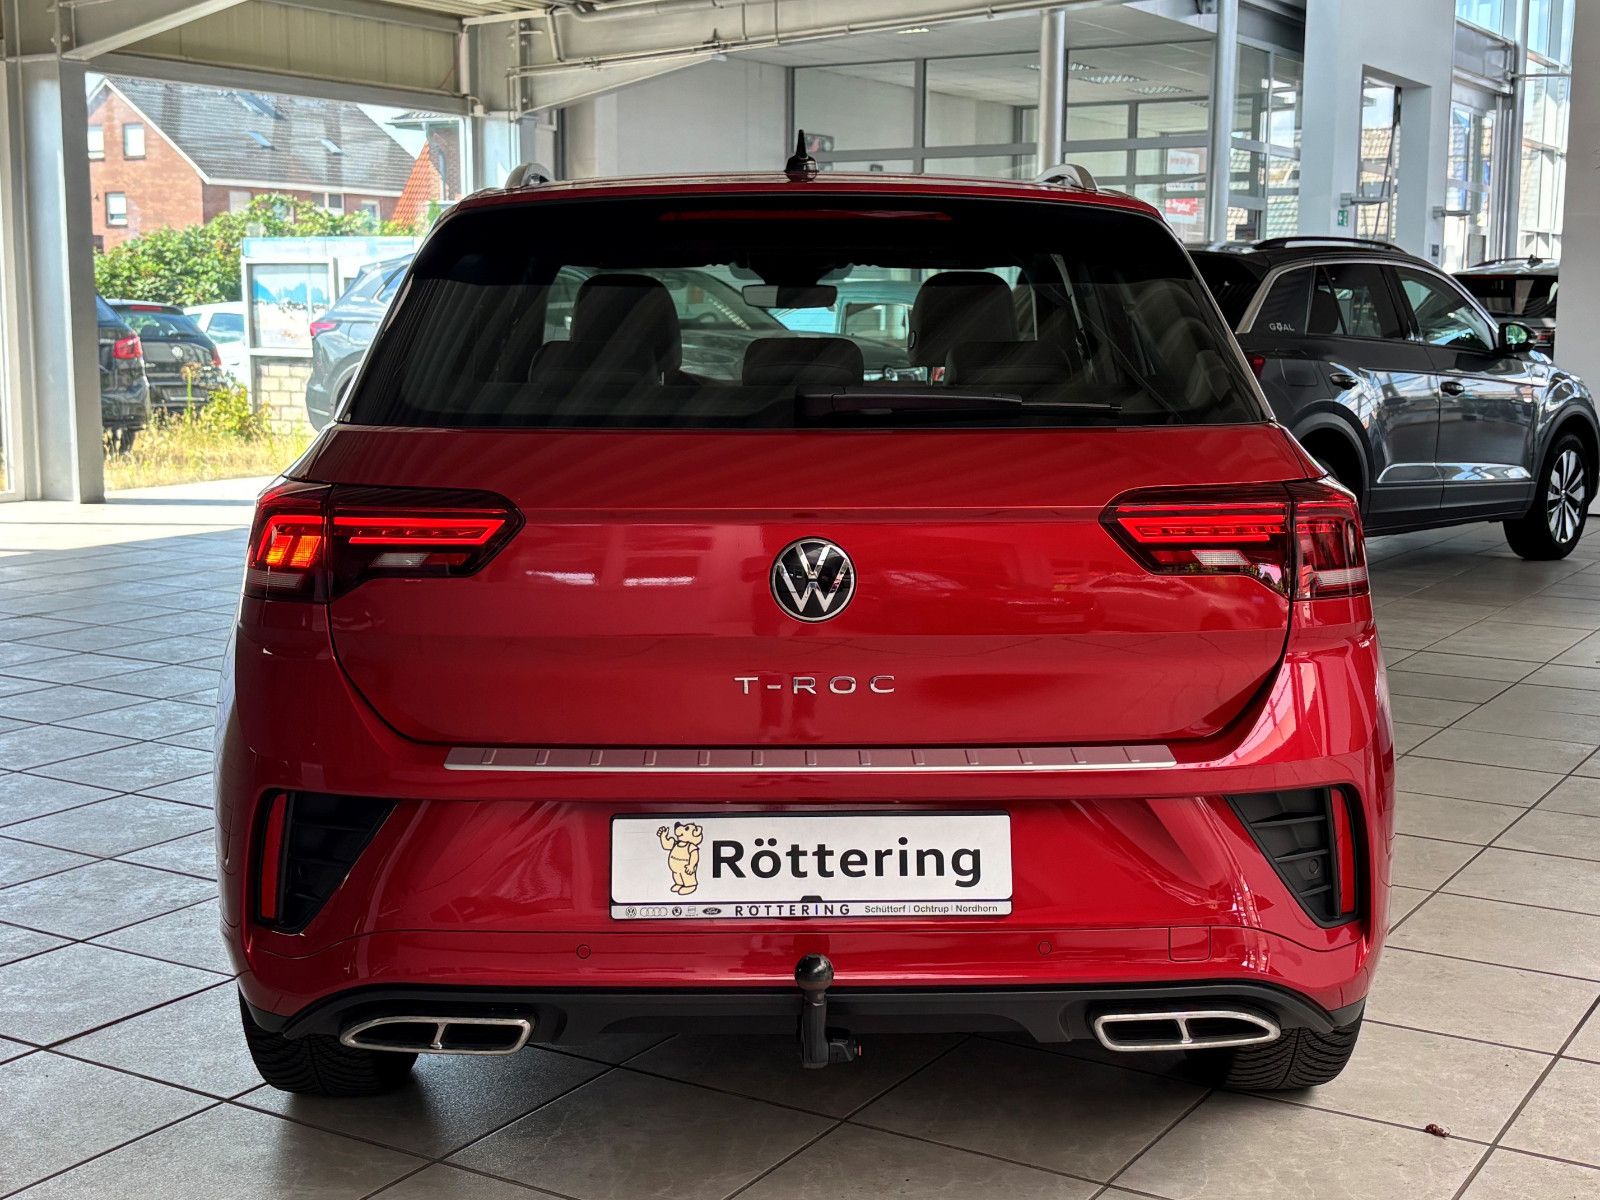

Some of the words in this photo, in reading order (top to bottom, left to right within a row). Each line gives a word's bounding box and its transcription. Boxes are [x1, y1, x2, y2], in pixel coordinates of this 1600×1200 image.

[1269, 322, 1296, 331] GOAL
[733, 674, 896, 695] T-ROC
[712, 836, 982, 888] Röttering
[735, 904, 850, 916] RÖTTERING
[864, 905, 906, 913] Schüttorf
[913, 905, 949, 914] Ochtrup
[955, 904, 998, 913] Nordhorn
